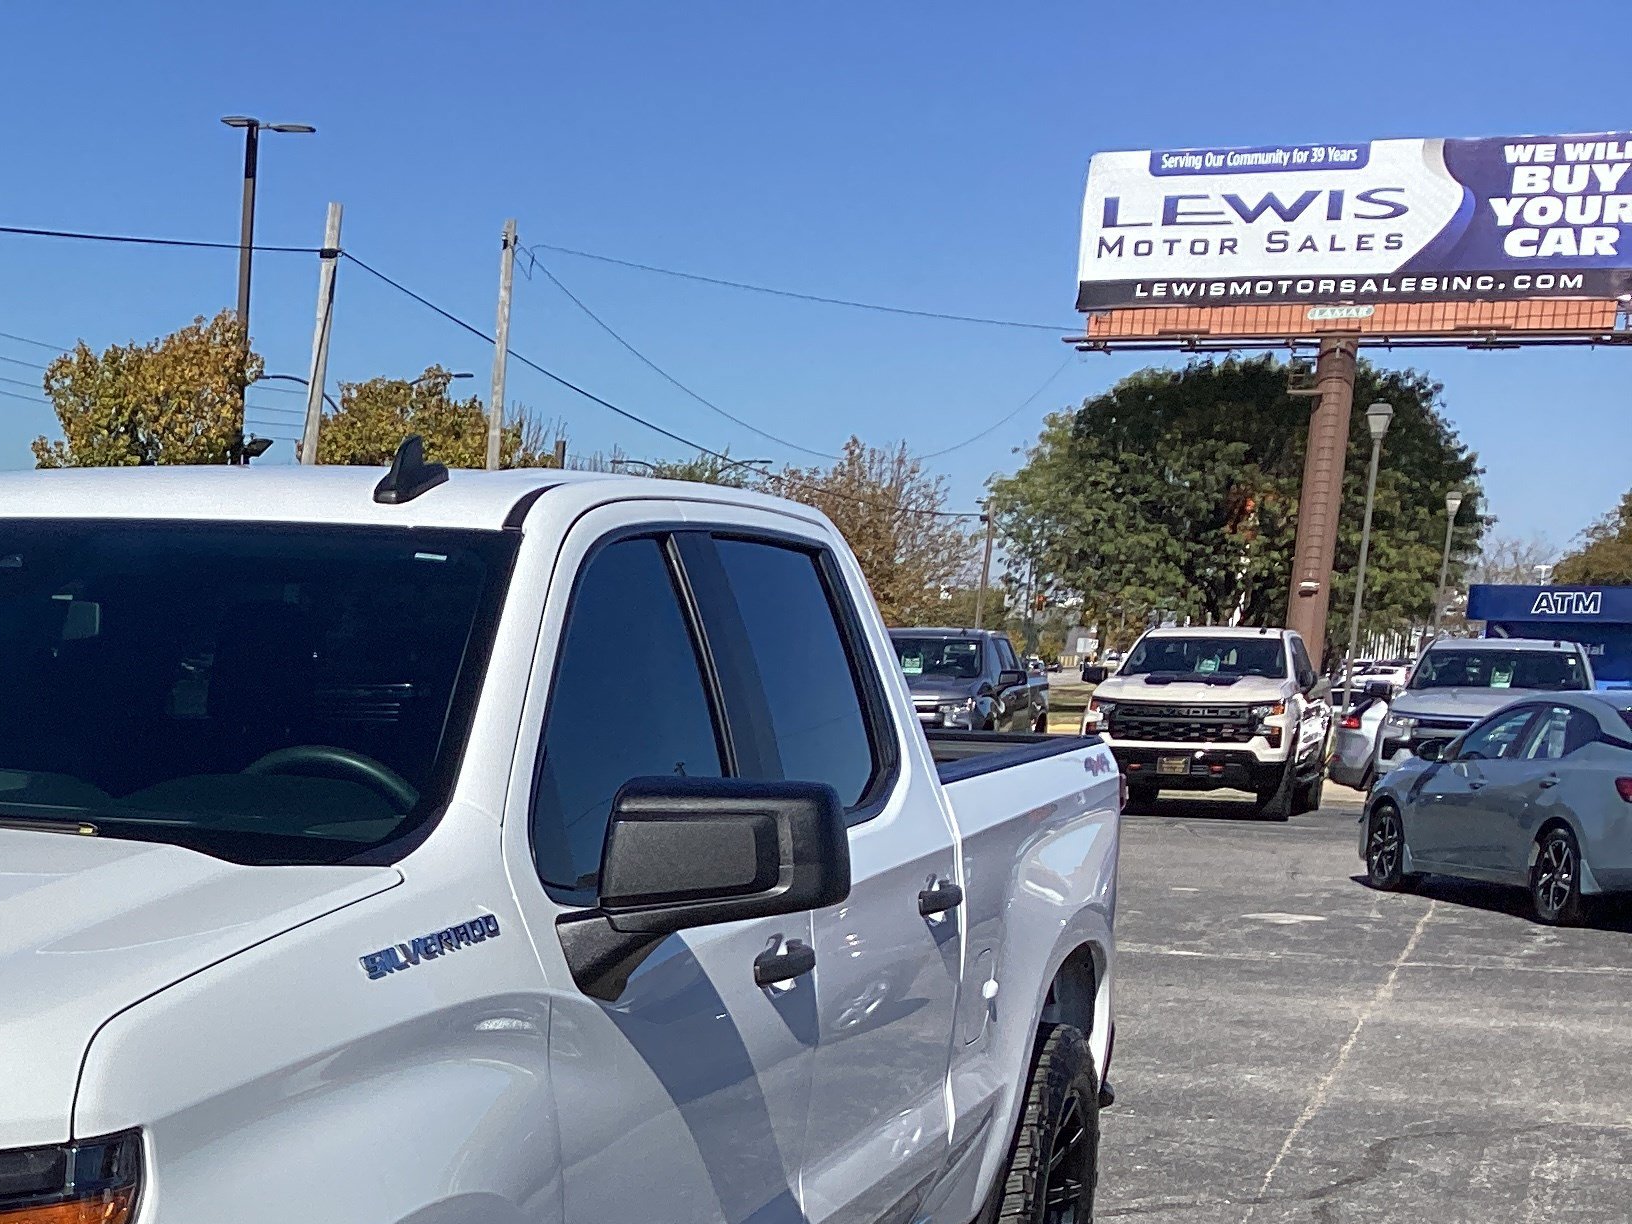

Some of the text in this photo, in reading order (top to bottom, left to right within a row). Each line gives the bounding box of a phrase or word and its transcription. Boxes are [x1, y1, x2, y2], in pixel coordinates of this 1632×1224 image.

[1161, 146, 1358, 169] Serving Our Community for 39 Years
[1504, 143, 1558, 164] WE
[1511, 163, 1632, 194] BUY
[1102, 188, 1409, 229] LEWIS
[1488, 194, 1632, 226] YOUR
[1096, 230, 1404, 259] MOTOR SALES
[1503, 226, 1620, 257] CAR
[1135, 274, 1584, 297] LEWISMOTORSALESINC.COM
[1530, 591, 1602, 614] ATM
[358, 914, 501, 980] SILVERADO
